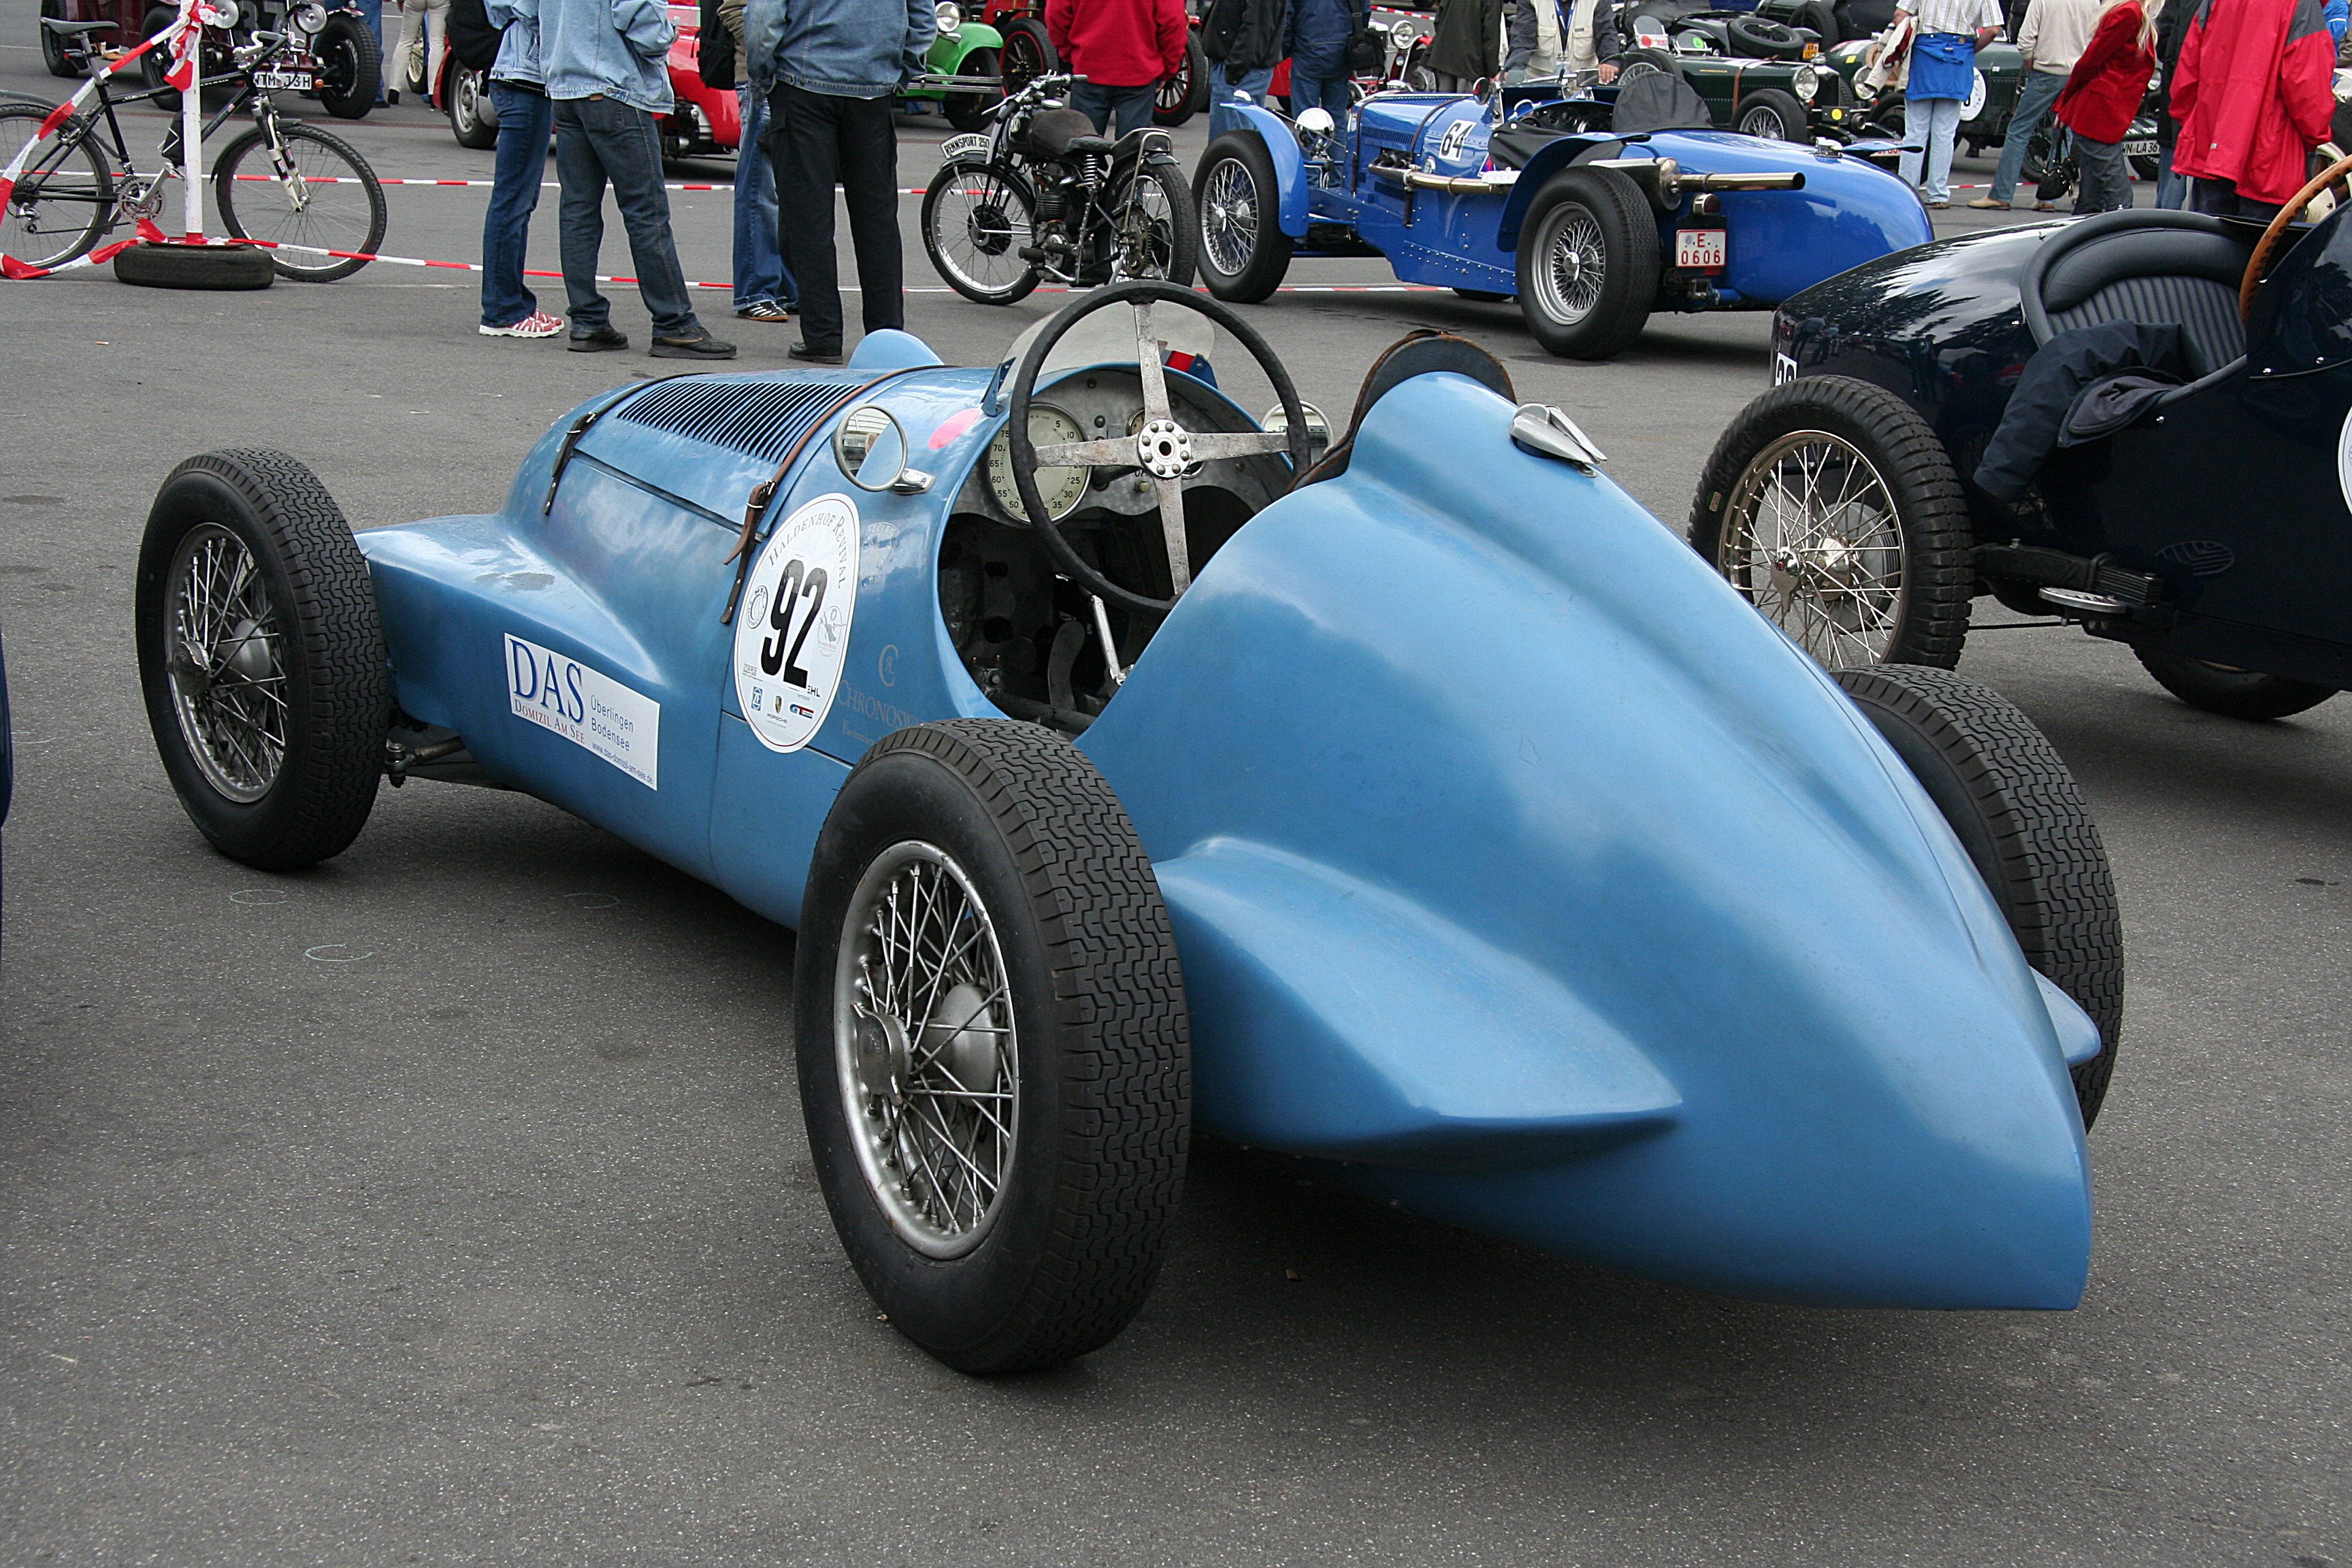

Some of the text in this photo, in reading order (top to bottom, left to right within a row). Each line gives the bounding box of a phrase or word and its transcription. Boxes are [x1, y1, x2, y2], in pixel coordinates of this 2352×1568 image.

[944, 136, 990, 155] RENNSPORT 250
[1441, 122, 1473, 158] 64
[1697, 233, 1705, 248] E
[1682, 250, 1720, 265] 0606
[1056, 420, 1061, 428] 5
[990, 459, 1000, 468] 65
[992, 476, 1002, 484] 60
[1071, 476, 1080, 485] 25
[1052, 501, 1062, 509] 35
[832, 515, 847, 589] REVIVAL
[761, 559, 828, 689] 92
[509, 638, 585, 723] DAS
[591, 694, 634, 733] Überlingen
[591, 717, 630, 751] Bodensee
